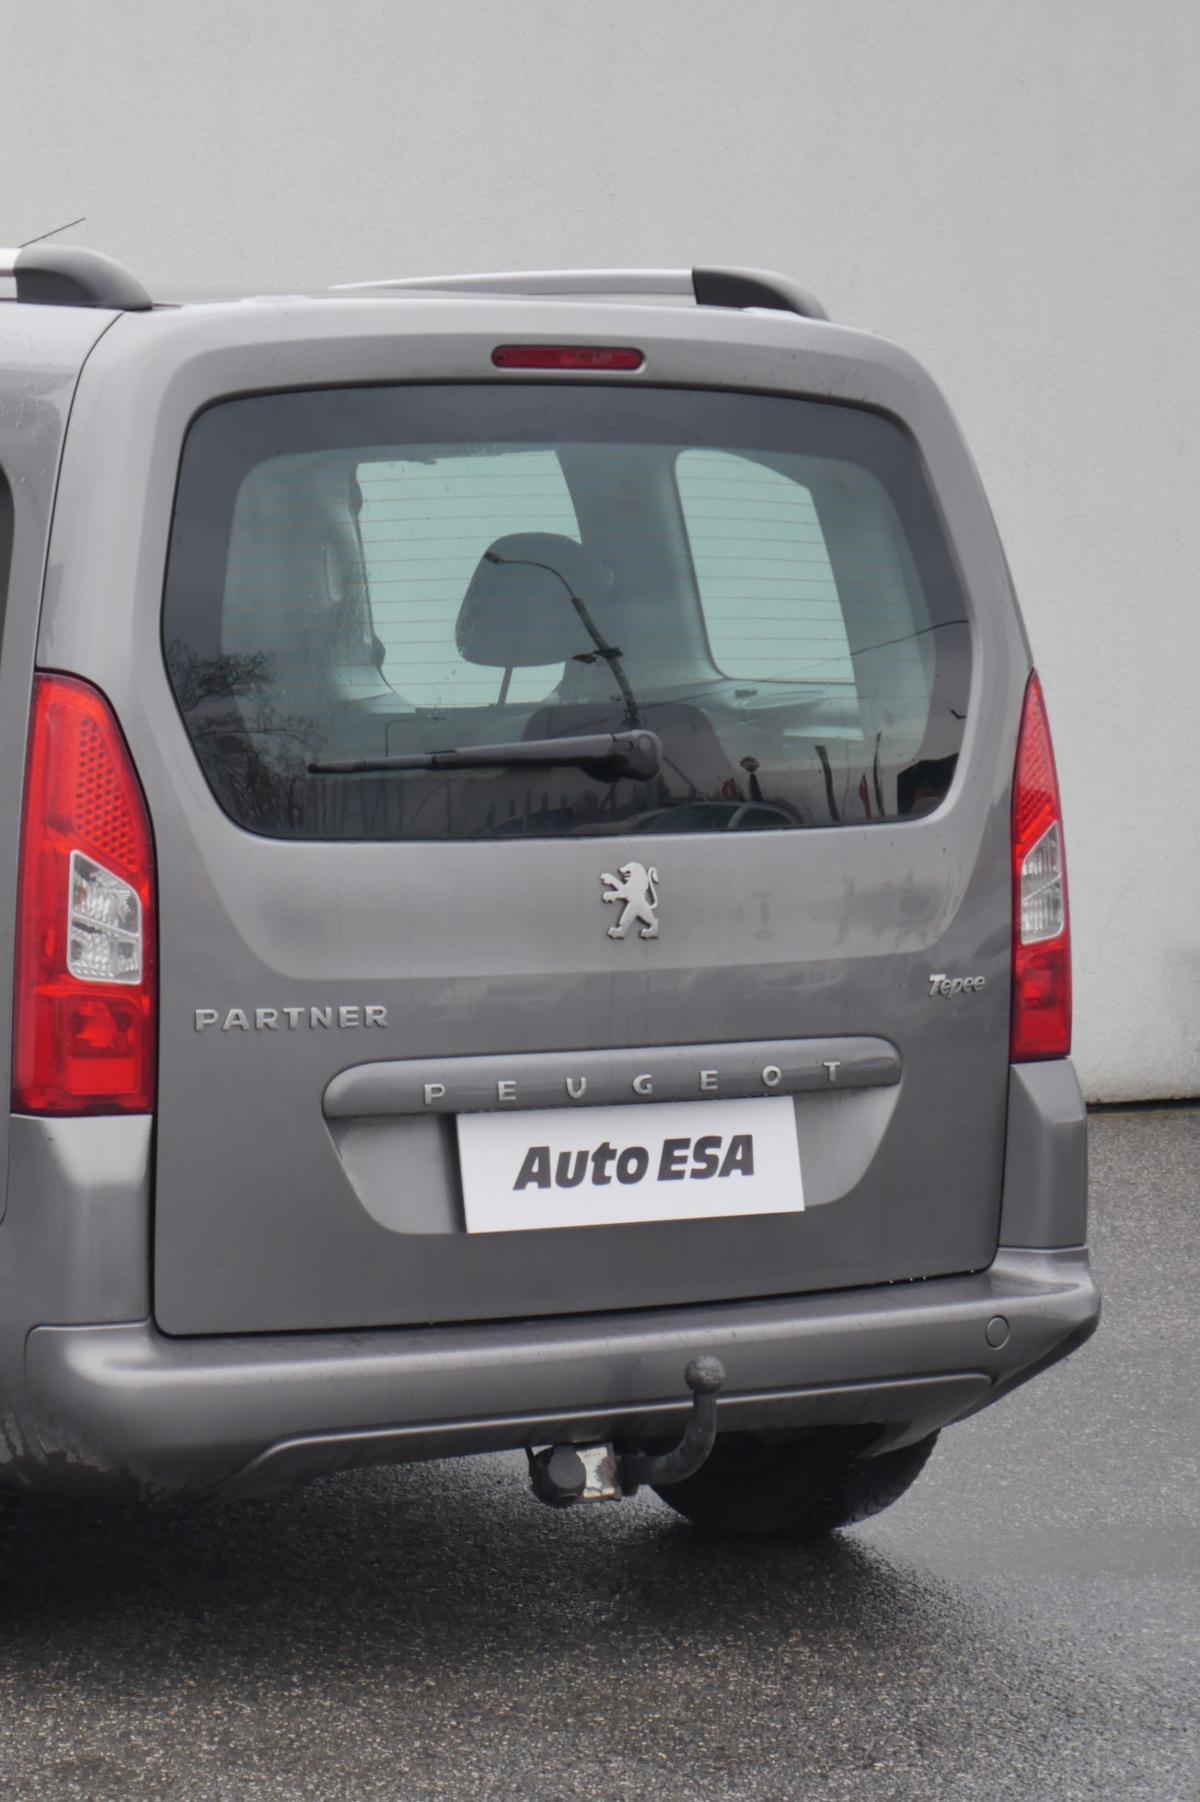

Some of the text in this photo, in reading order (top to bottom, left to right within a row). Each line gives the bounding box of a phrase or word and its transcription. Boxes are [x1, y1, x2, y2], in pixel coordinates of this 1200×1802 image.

[928, 974, 986, 999] Tepee
[194, 1005, 390, 1032] PARTNER
[423, 1061, 841, 1105] PEUGEOT
[512, 1134, 755, 1191] Auto ESA
